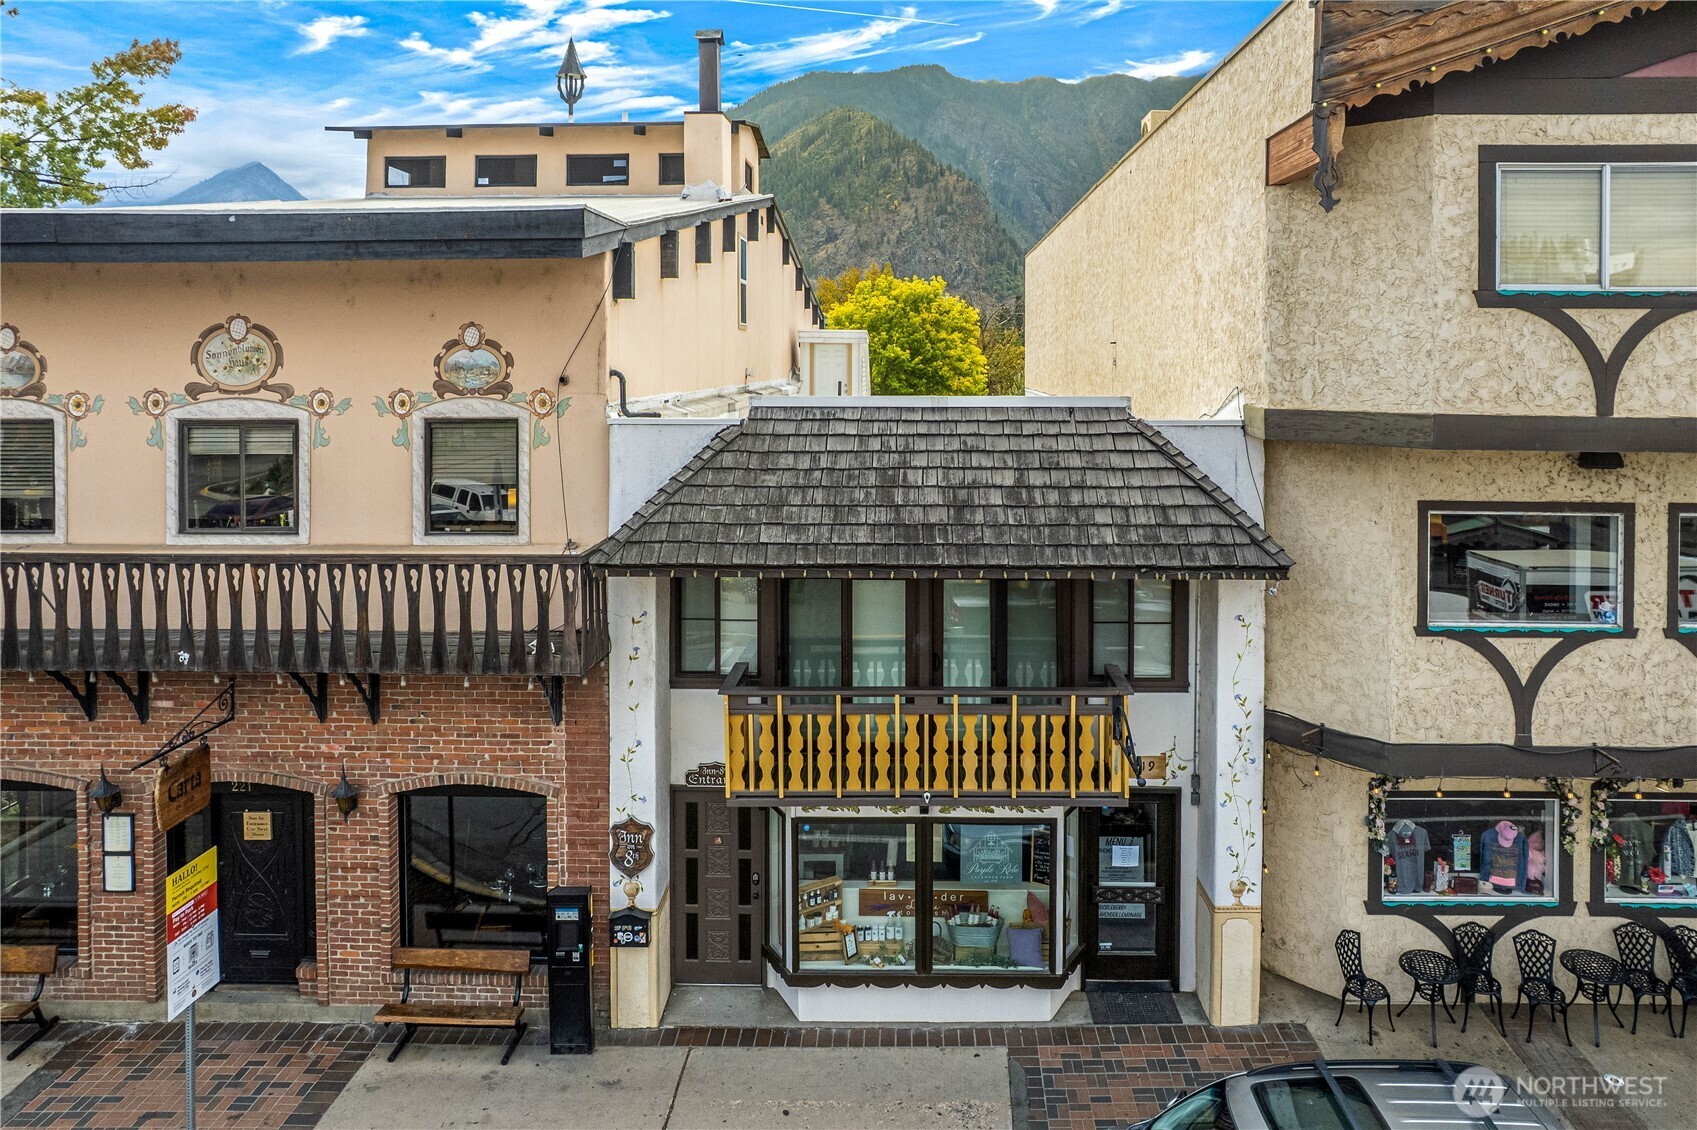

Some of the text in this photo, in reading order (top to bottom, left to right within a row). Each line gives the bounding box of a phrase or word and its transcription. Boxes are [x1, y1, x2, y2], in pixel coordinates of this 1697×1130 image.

[229, 357, 249, 369] Haus
[1142, 761, 1155, 771] 19
[689, 774, 726, 785] Entra
[167, 771, 202, 802] Carta
[231, 782, 252, 792] 221
[620, 830, 643, 844] Inn
[1105, 837, 1127, 846] MENU
[172, 864, 199, 887] HALLO!
